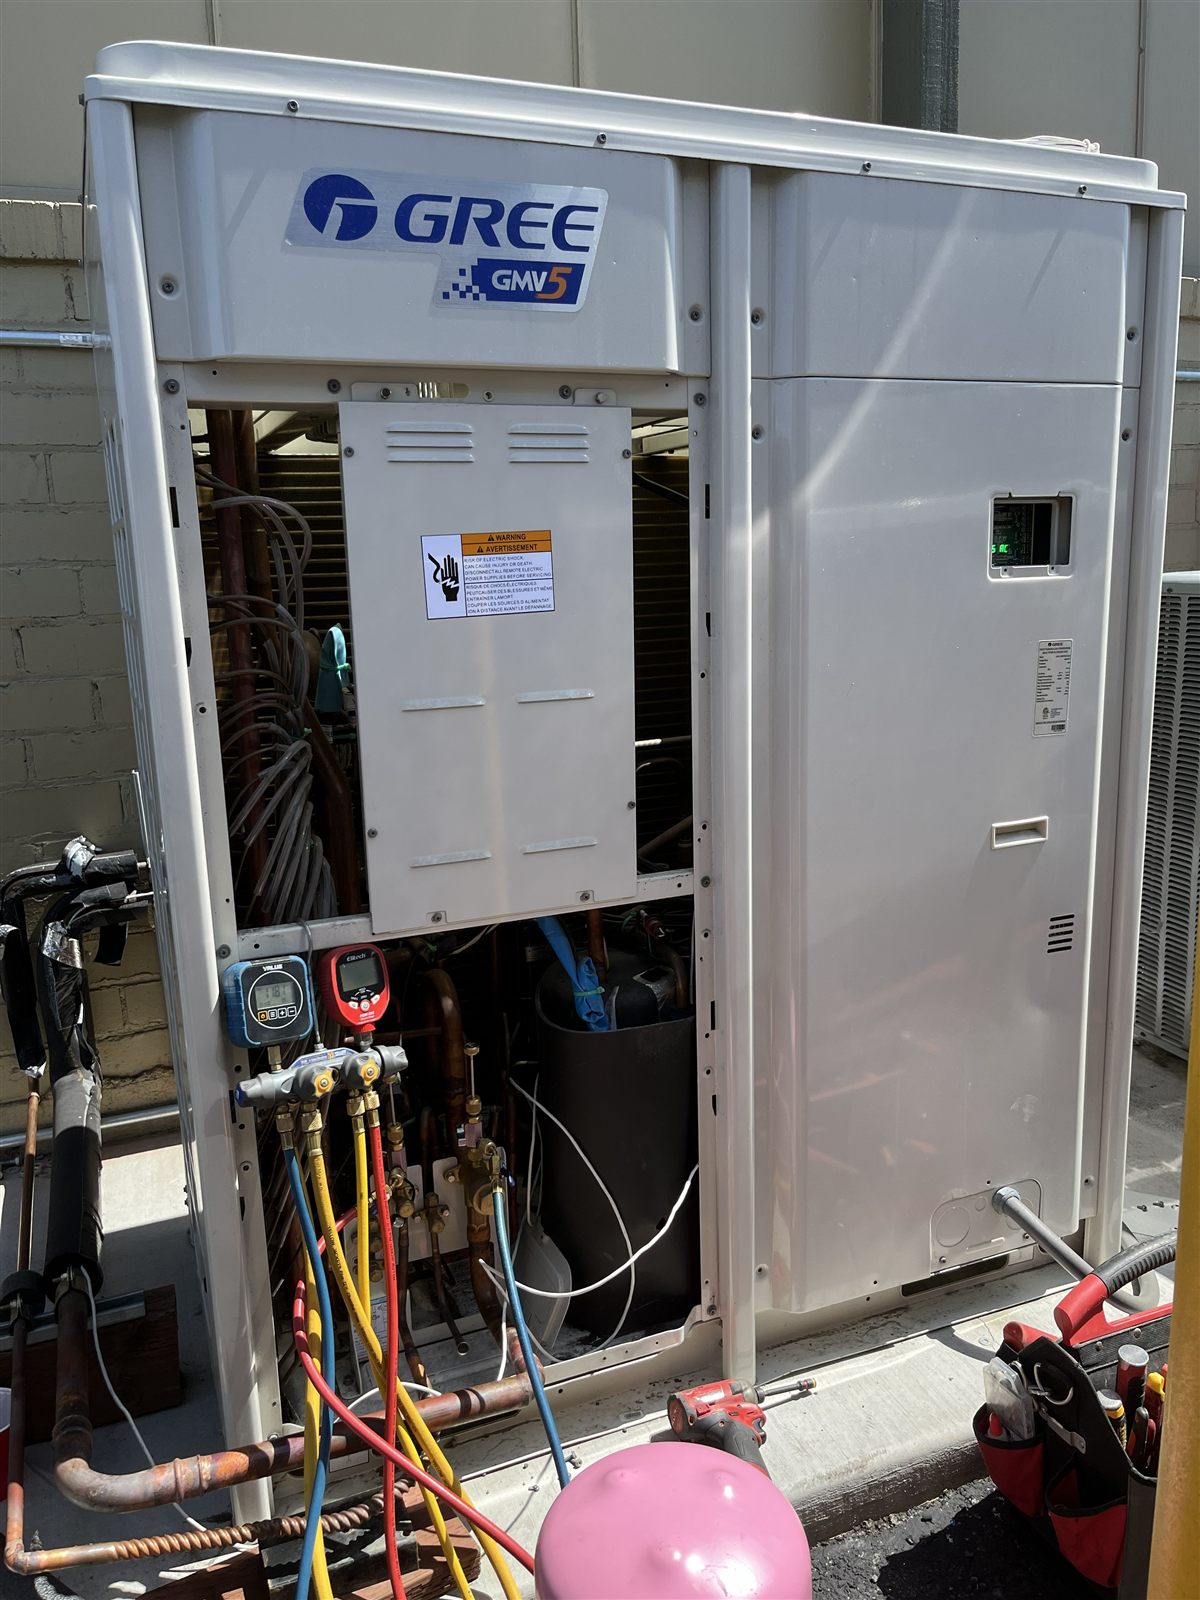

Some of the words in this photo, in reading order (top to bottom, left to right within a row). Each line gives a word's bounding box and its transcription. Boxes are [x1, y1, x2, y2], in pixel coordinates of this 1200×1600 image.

[394, 194, 598, 252] GREE
[491, 266, 572, 300] GMV5
[486, 544, 537, 552] AVERTISSEMENT
